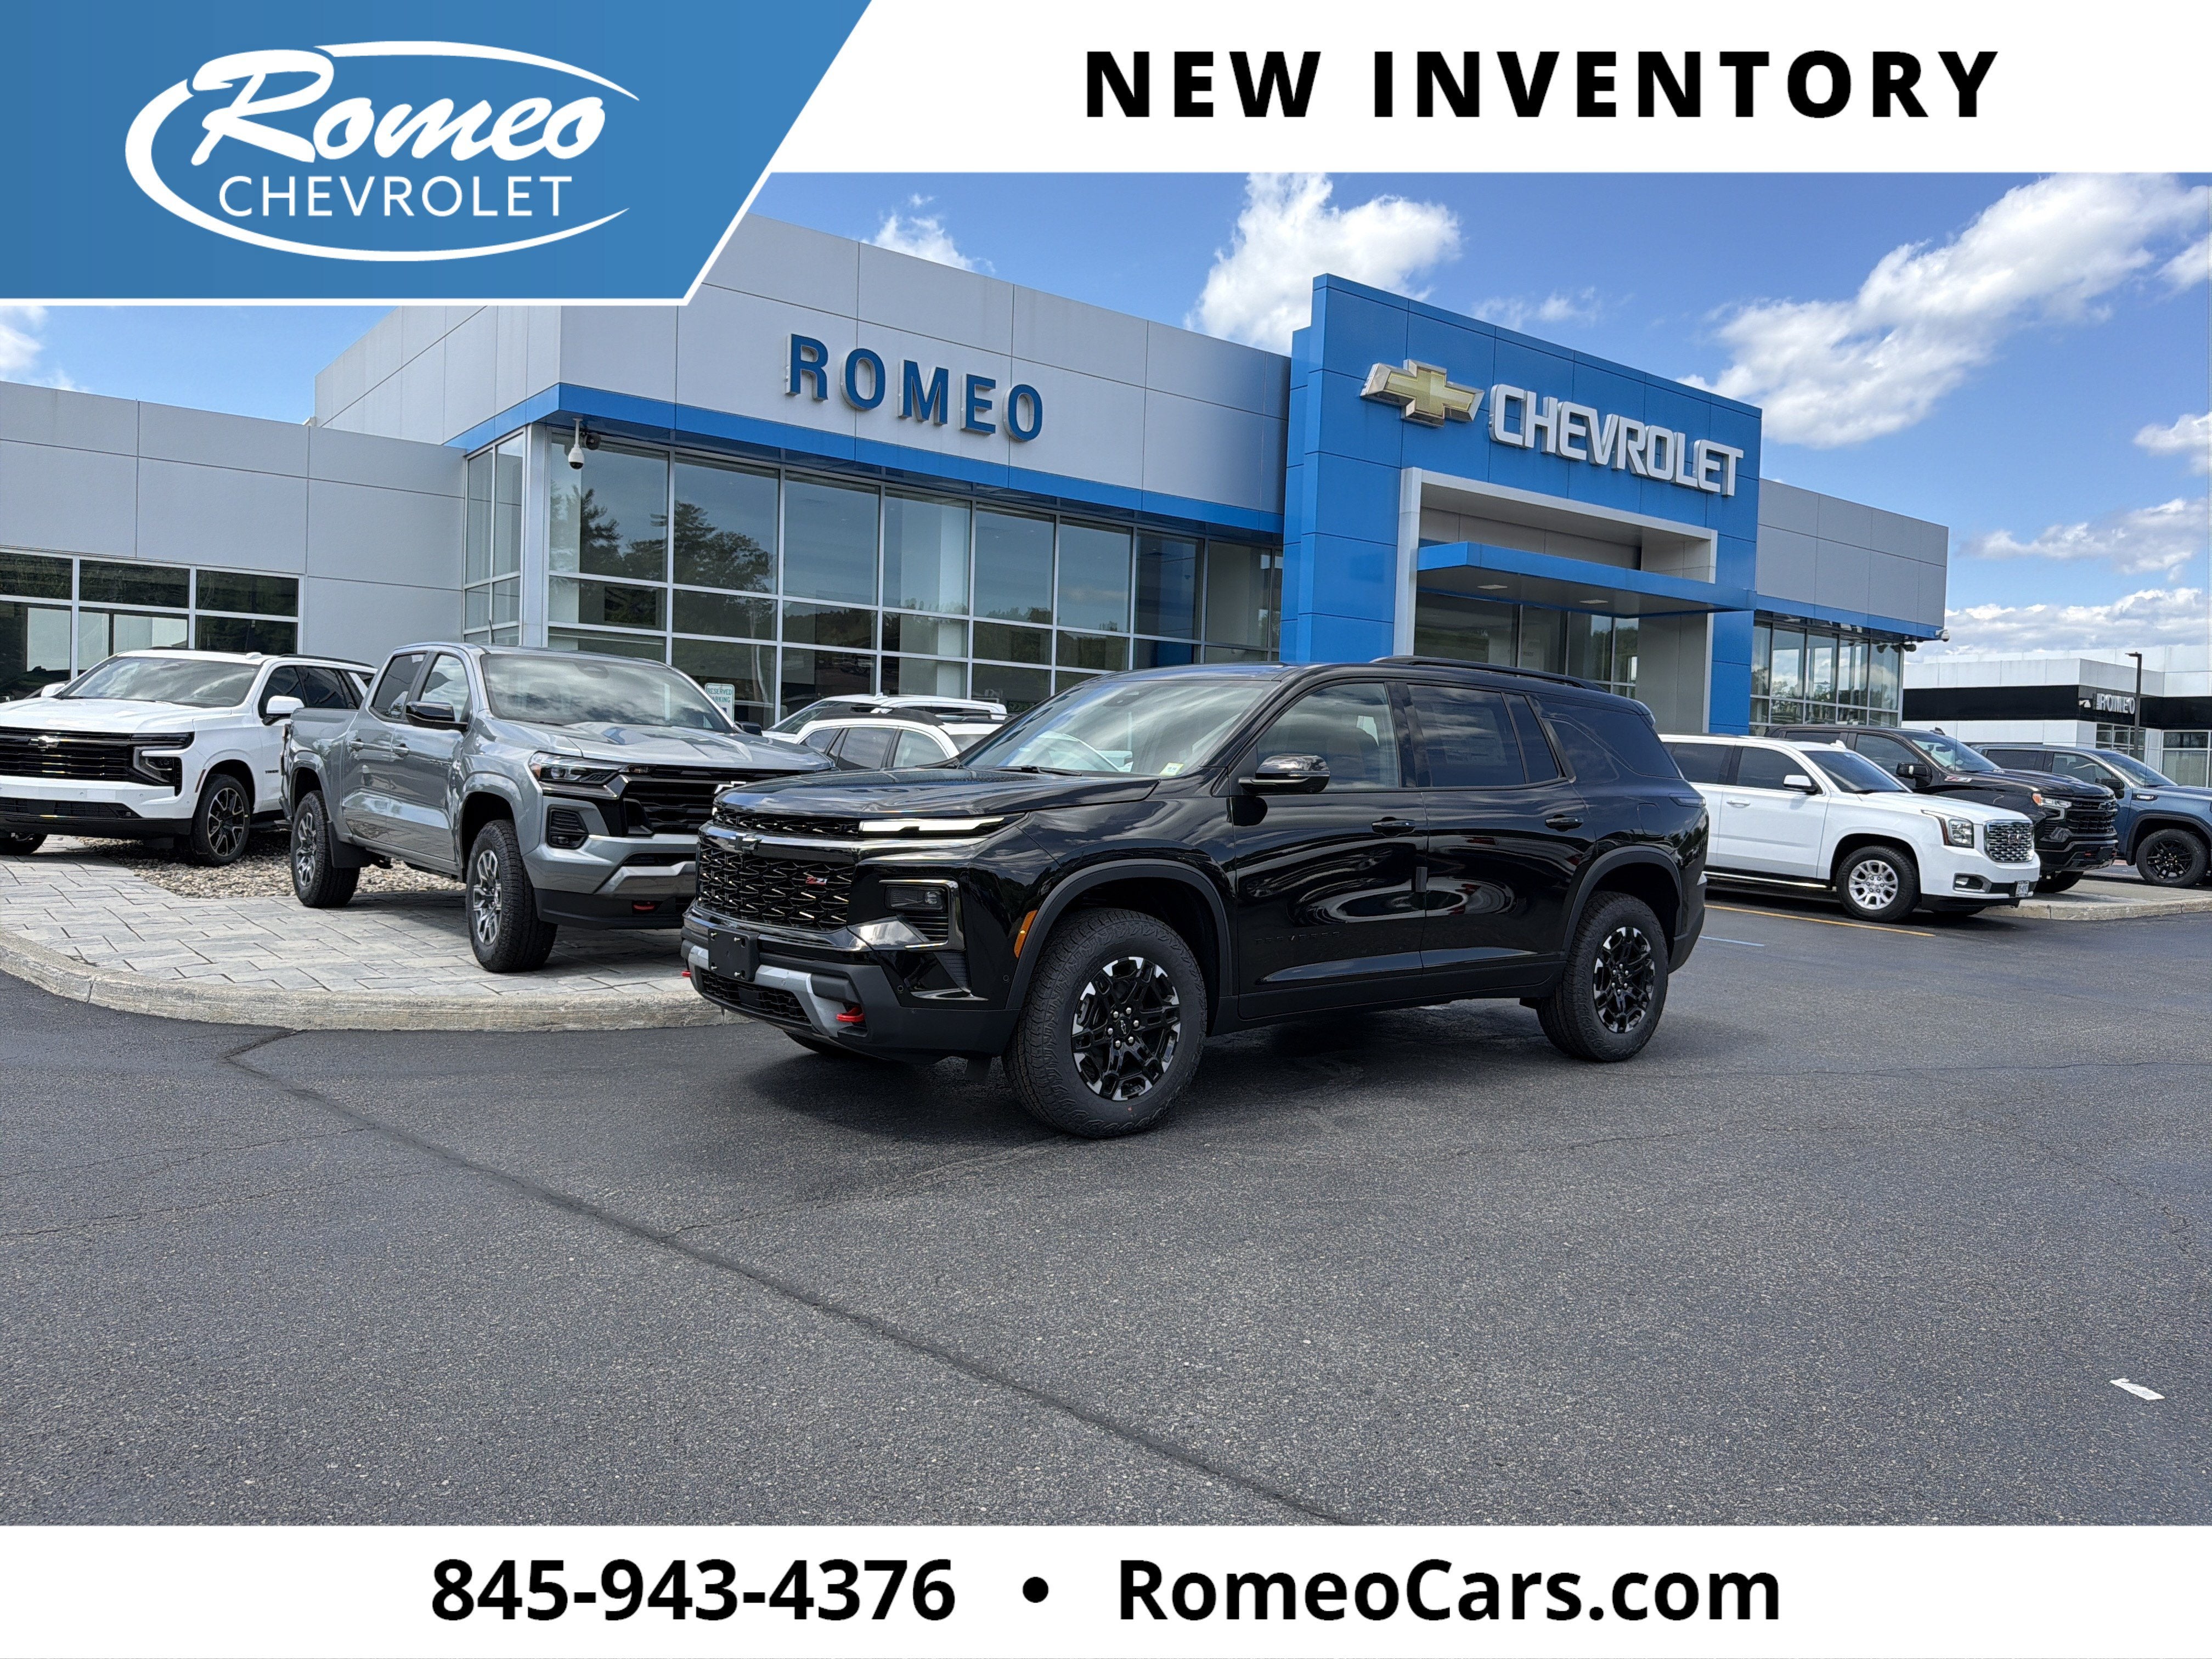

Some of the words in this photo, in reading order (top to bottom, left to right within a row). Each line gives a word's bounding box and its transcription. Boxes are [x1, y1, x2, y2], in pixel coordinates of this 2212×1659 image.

[785, 333, 1043, 442] ROMEO
[1488, 384, 1744, 497] CHEVROLET
[2096, 693, 2135, 715] ROMEO
